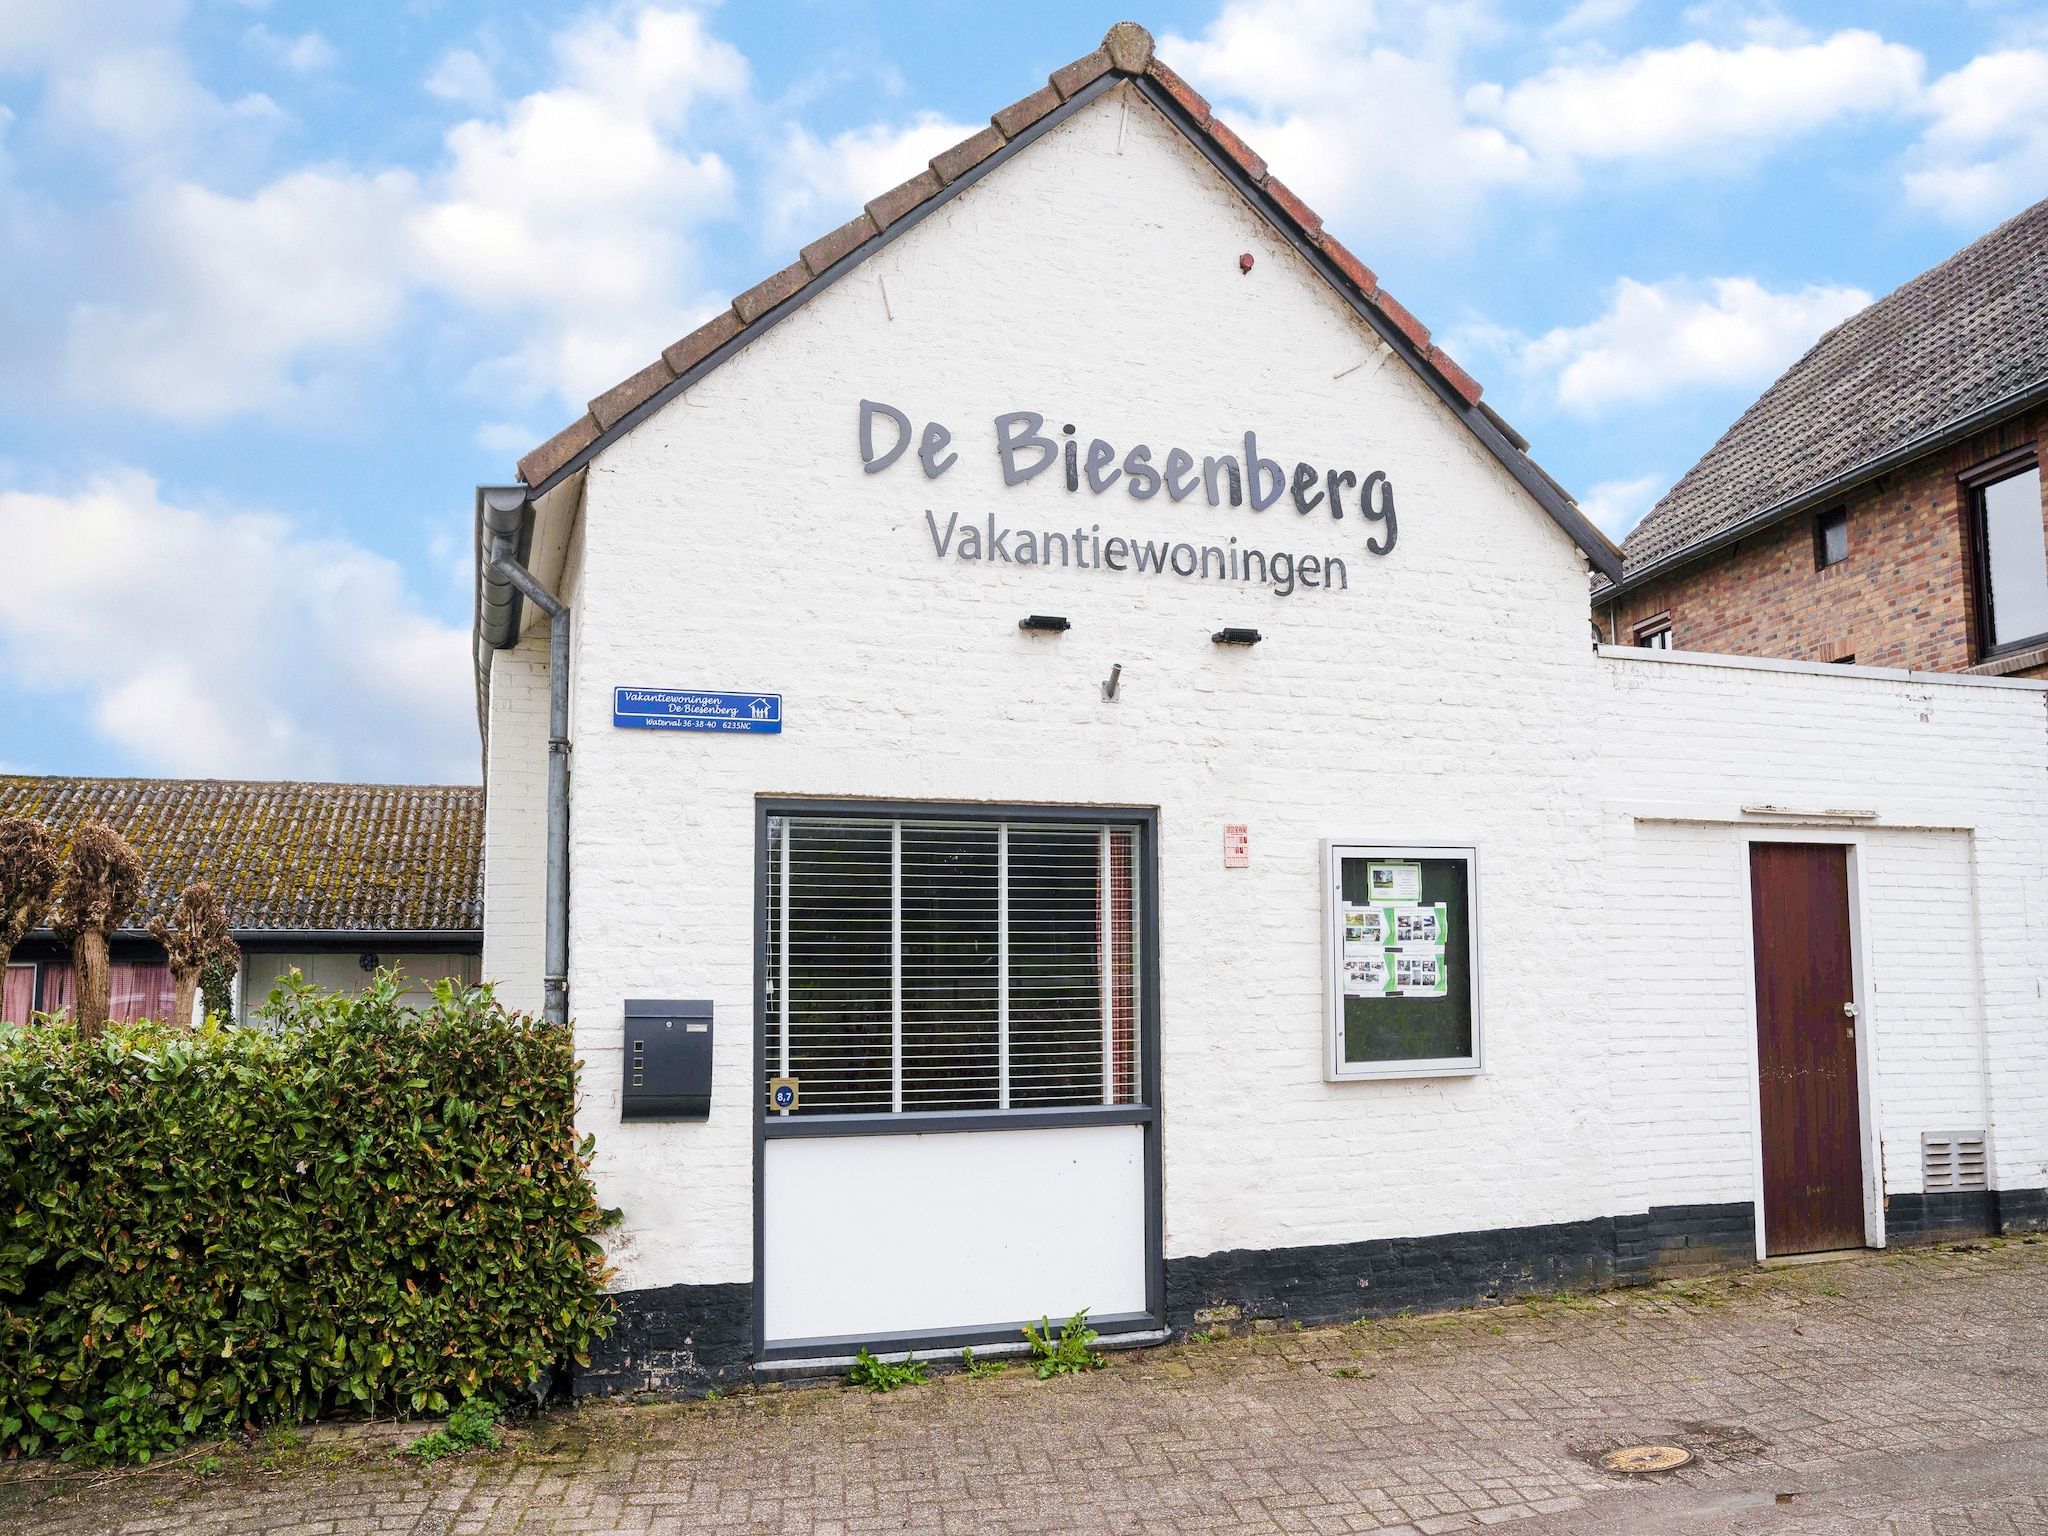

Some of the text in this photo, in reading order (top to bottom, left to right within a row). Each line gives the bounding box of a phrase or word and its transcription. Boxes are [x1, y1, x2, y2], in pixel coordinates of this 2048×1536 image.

[859, 399, 1398, 556] De Biesenberg
[925, 509, 1348, 597] Vakantiewoningen
[625, 692, 722, 707] Vakantiewoningen
[668, 703, 739, 717] De Biesenberg
[645, 718, 682, 727] Waterval
[722, 721, 751, 730] 6235NC
[777, 1092, 792, 1103] 8,7
